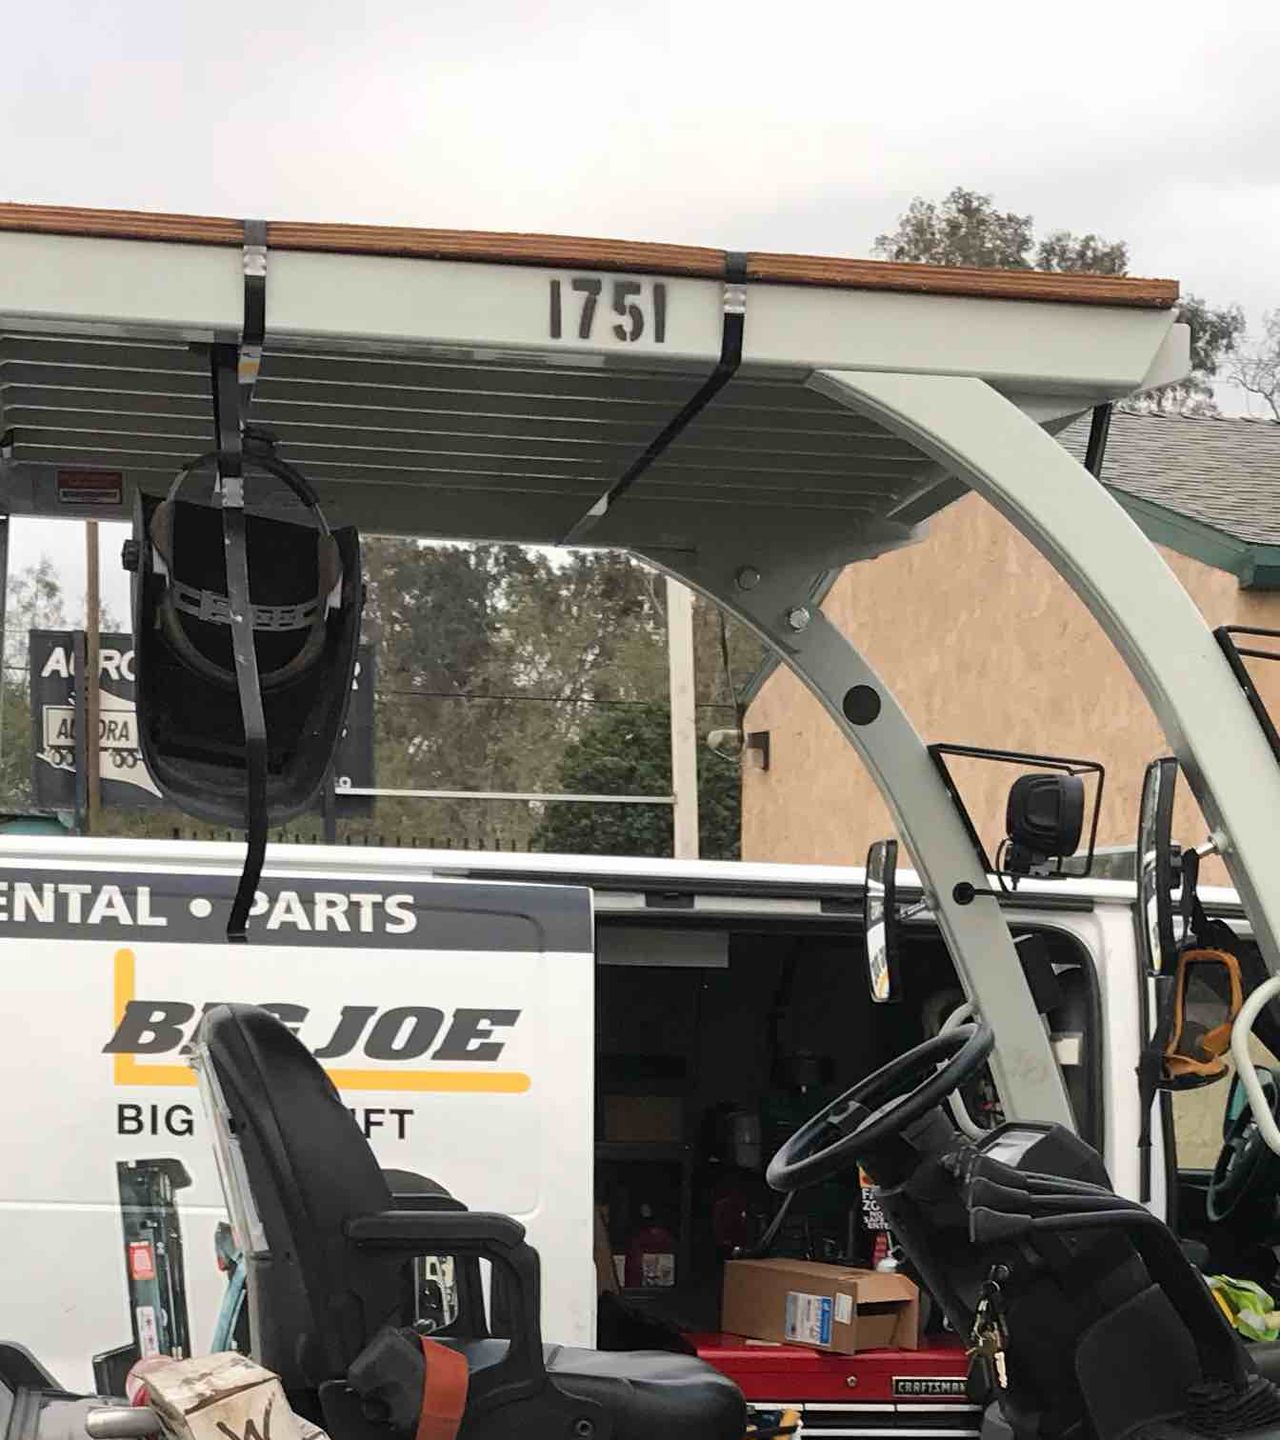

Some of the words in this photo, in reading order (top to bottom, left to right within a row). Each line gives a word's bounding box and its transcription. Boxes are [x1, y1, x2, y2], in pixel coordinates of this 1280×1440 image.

[550, 279, 666, 343] 1751
[313, 1005, 521, 1062] JOE
[117, 1104, 194, 1136] BIG
